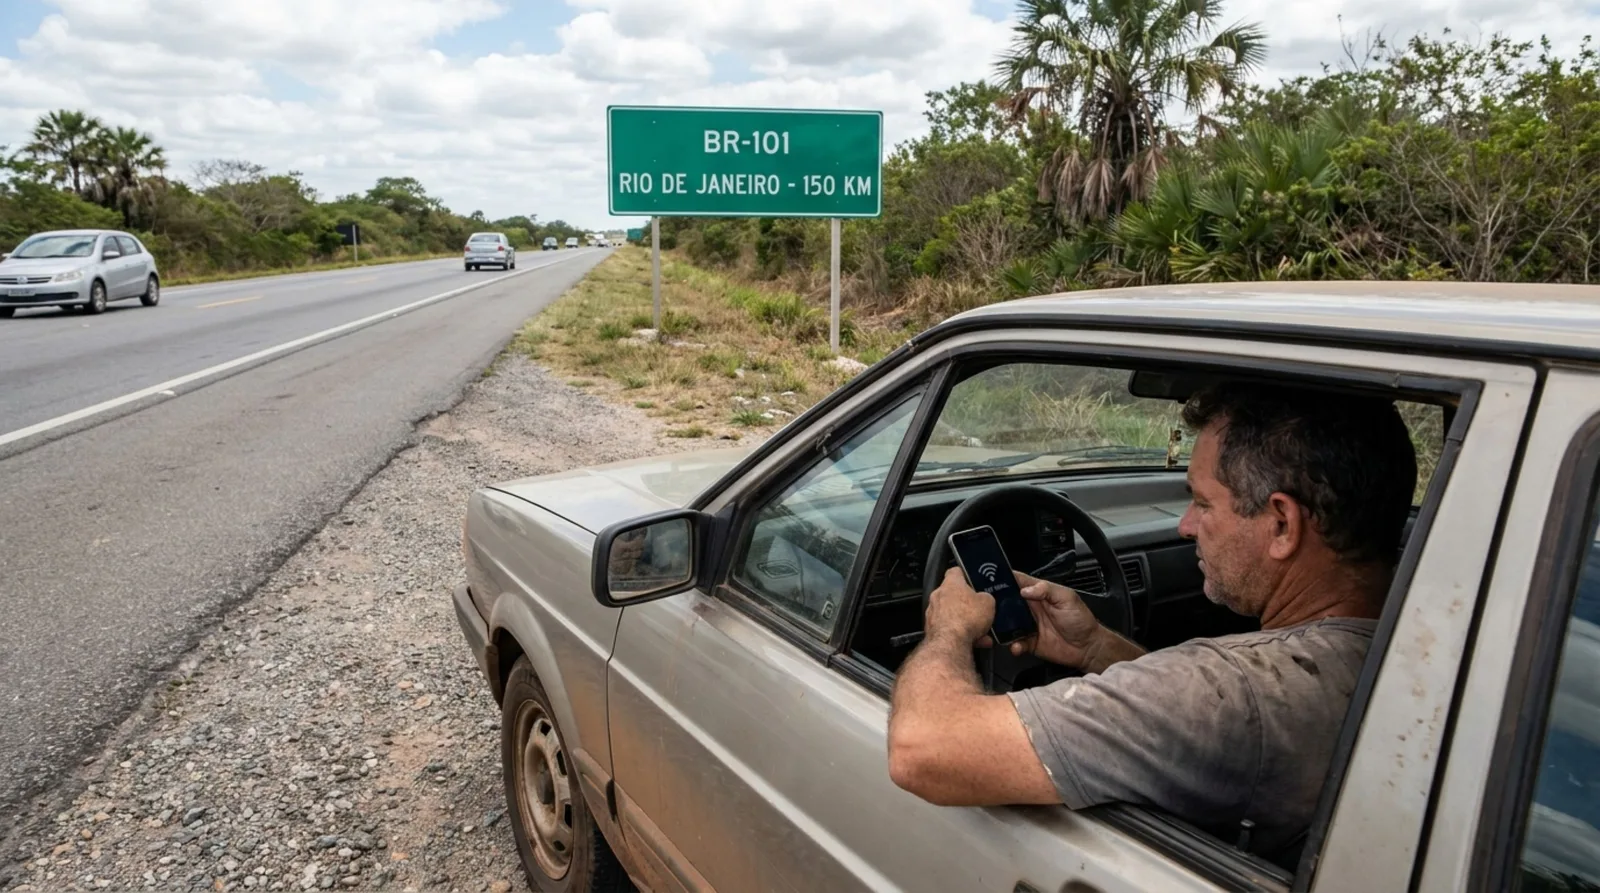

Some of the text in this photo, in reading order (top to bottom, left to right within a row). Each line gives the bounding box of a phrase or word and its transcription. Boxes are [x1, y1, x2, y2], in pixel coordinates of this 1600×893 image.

[703, 130, 790, 154] BR-101
[619, 172, 653, 194] RIO
[662, 173, 688, 194] DE
[696, 174, 780, 195] JANEIRO
[803, 175, 836, 196] 150
[844, 175, 872, 196] KM
